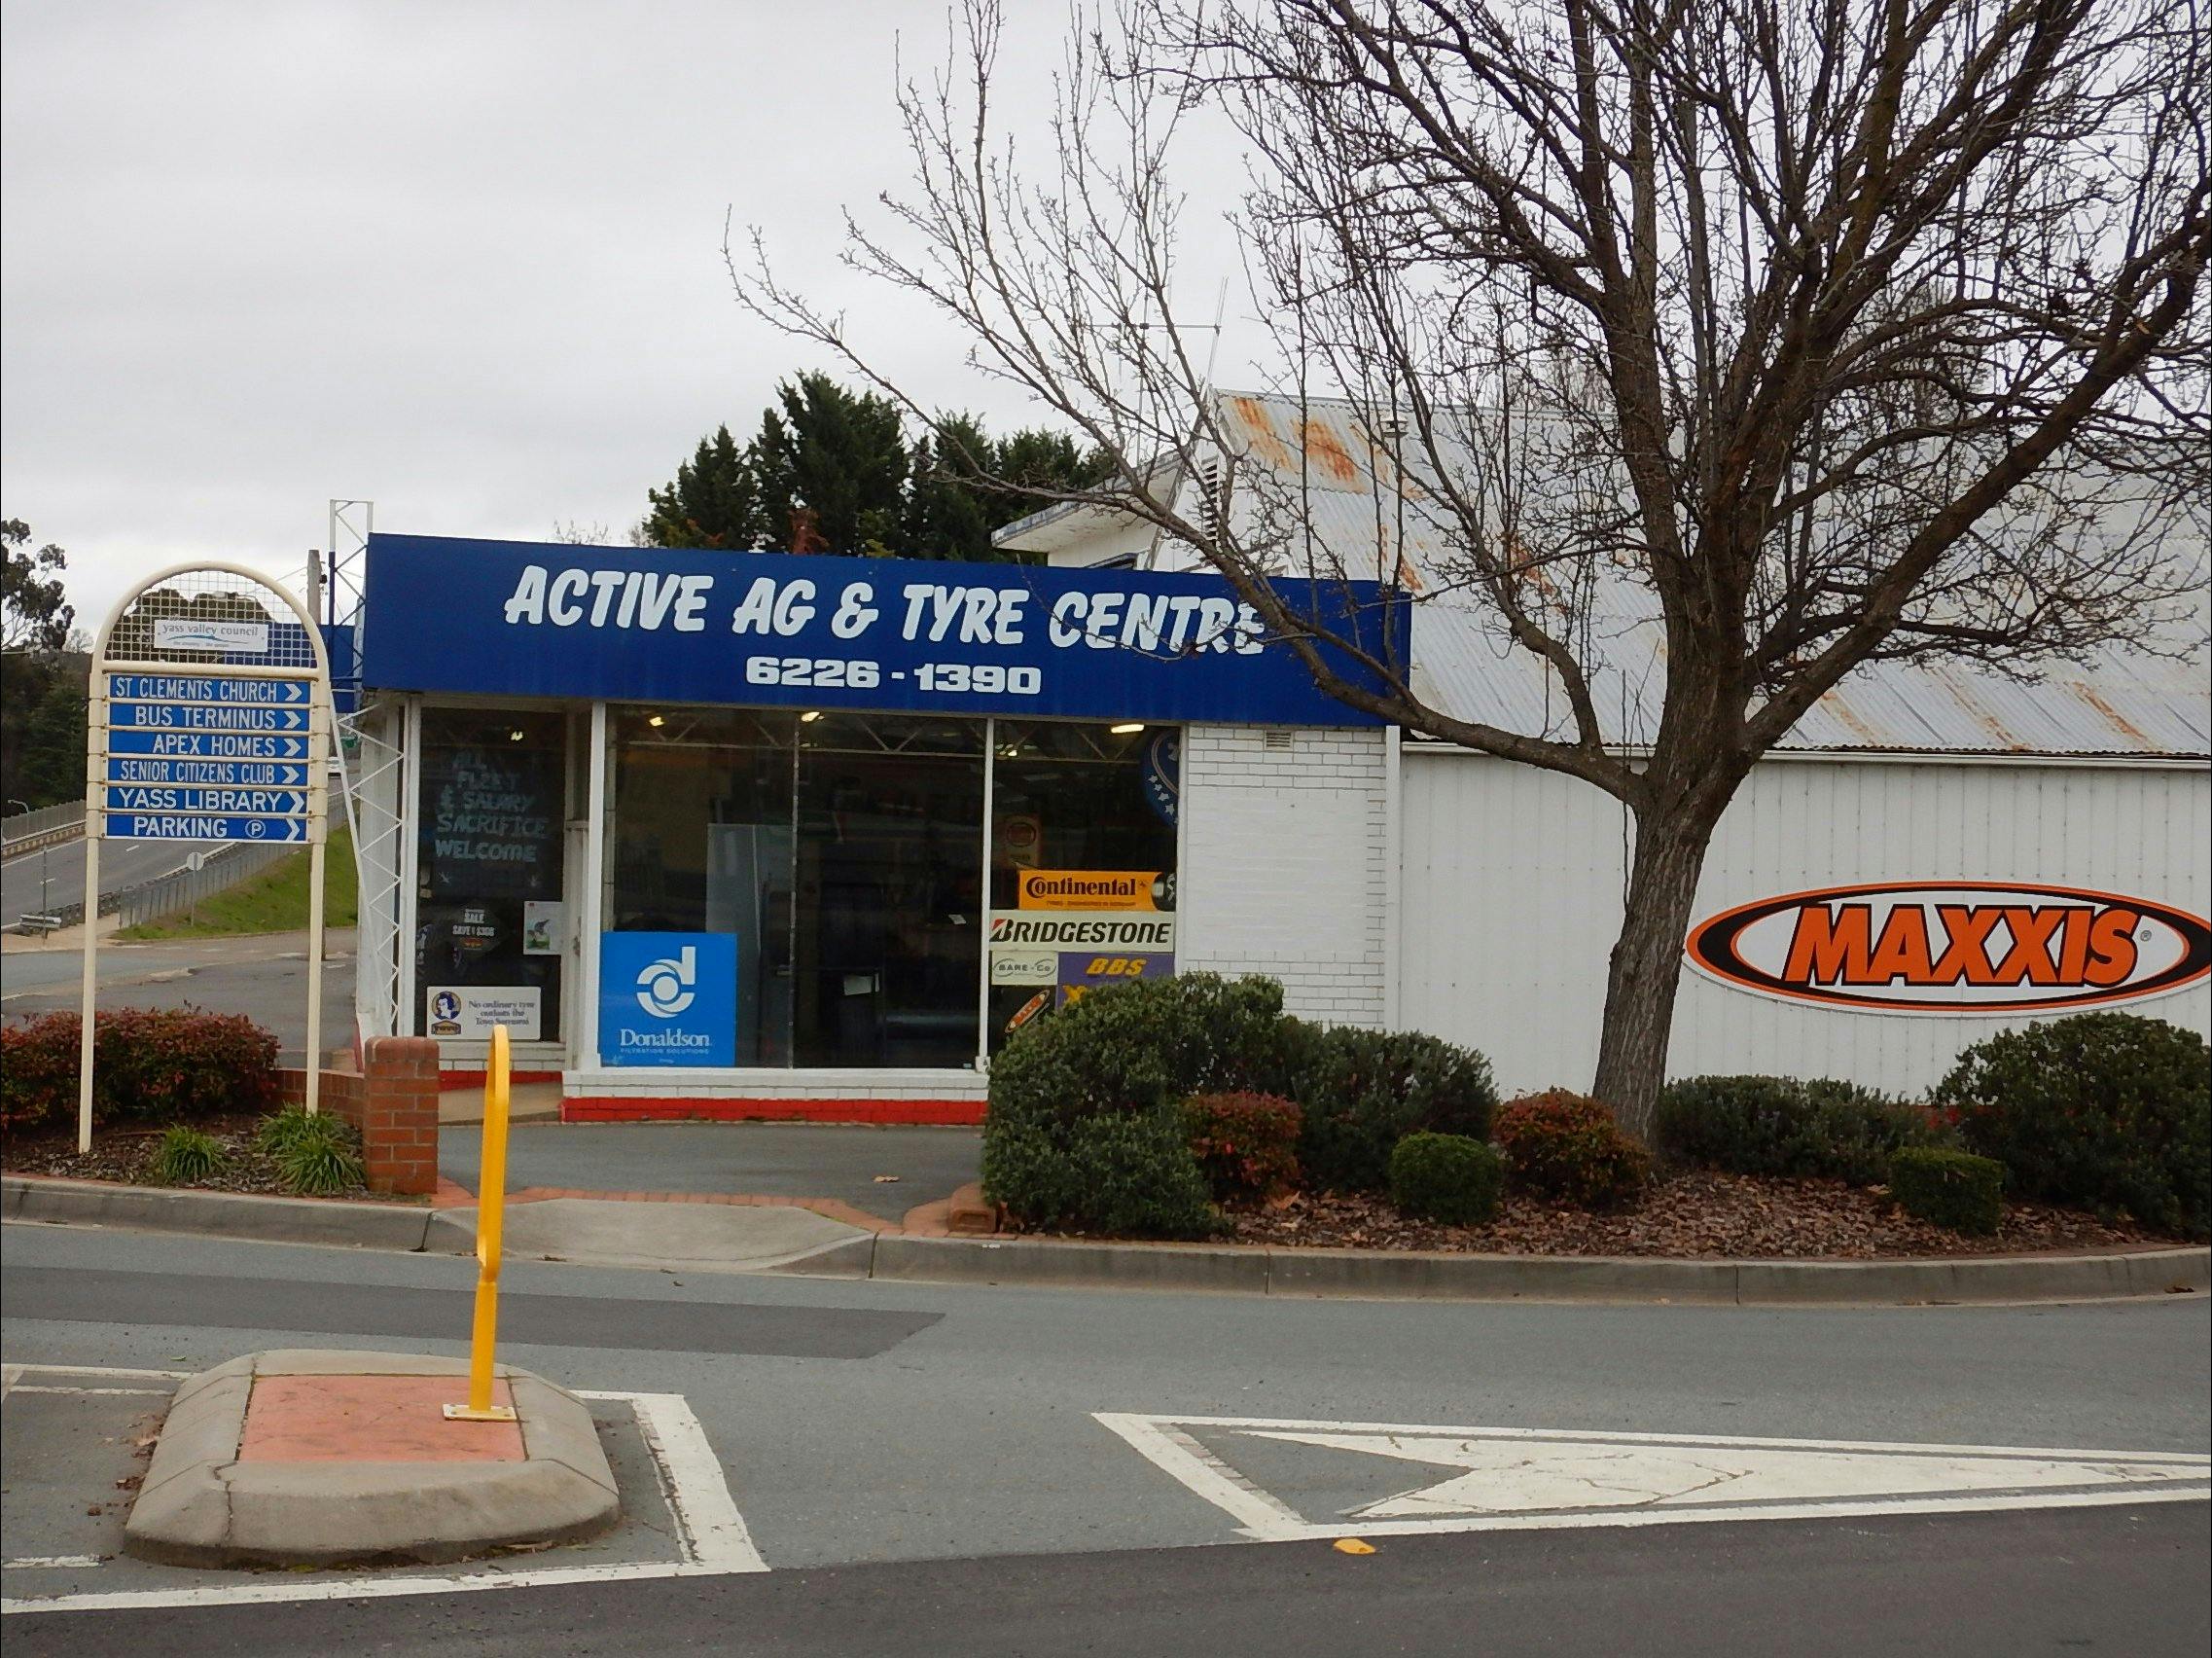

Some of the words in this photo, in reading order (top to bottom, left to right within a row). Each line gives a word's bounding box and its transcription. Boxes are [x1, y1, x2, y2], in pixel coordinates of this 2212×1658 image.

[504, 565, 714, 632] ACTIVE
[731, 577, 816, 637] AG
[831, 582, 878, 639] &
[903, 584, 1030, 646] TYRE
[1049, 591, 1266, 656] CENTRE
[162, 623, 185, 634] yass
[188, 624, 216, 636] valley
[220, 626, 259, 636] council
[116, 677, 131, 698] ST
[139, 679, 213, 701] CLEMENTS
[219, 682, 277, 703] CHURCH
[135, 706, 173, 727] BUS
[182, 708, 276, 730] TERMINUS
[153, 734, 200, 755] APEX
[211, 737, 275, 758] HOMES
[121, 760, 168, 781] SENIOR
[175, 762, 234, 783] CITIZENS
[241, 765, 274, 784] CLUB
[118, 787, 177, 810] YASS
[185, 790, 282, 813] LIBRARY
[133, 815, 227, 838] PARKING
[435, 839, 537, 863] WELCOME
[1026, 876, 1136, 899] Continental
[989, 919, 1171, 944] BRIDGESTONE
[1781, 903, 2140, 988] MAXXIS
[1086, 957, 1148, 977] BBS
[621, 1028, 710, 1046] Donaldson
